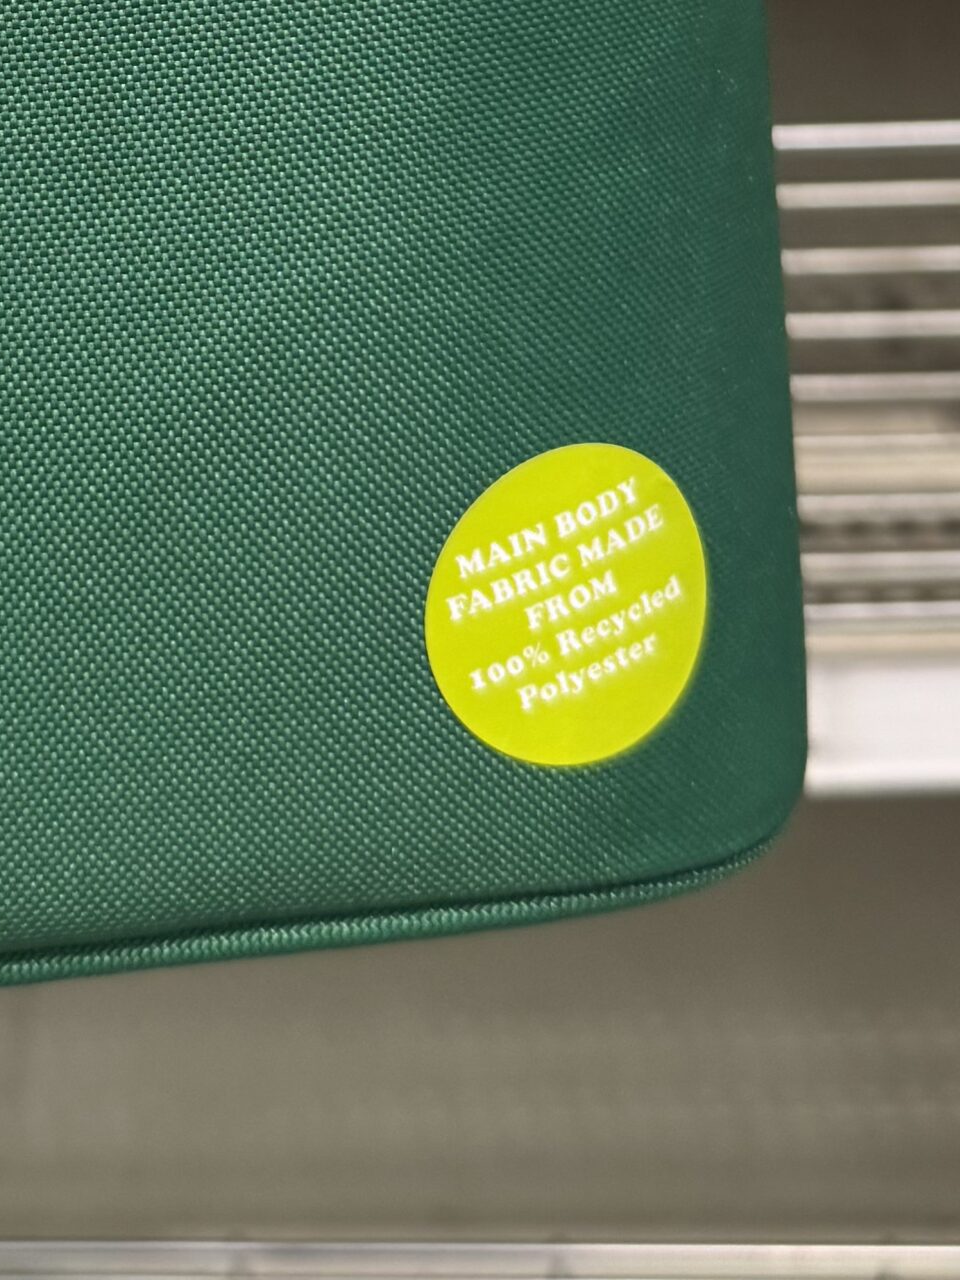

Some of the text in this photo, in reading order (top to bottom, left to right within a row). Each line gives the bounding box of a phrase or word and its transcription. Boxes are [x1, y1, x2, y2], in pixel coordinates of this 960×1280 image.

[446, 503, 665, 621] FABRIC MADE
[455, 477, 638, 580] MAIN BODY
[469, 575, 682, 690] 100% Recycled
[524, 570, 618, 630] FROM
[516, 633, 658, 711] Polyester
